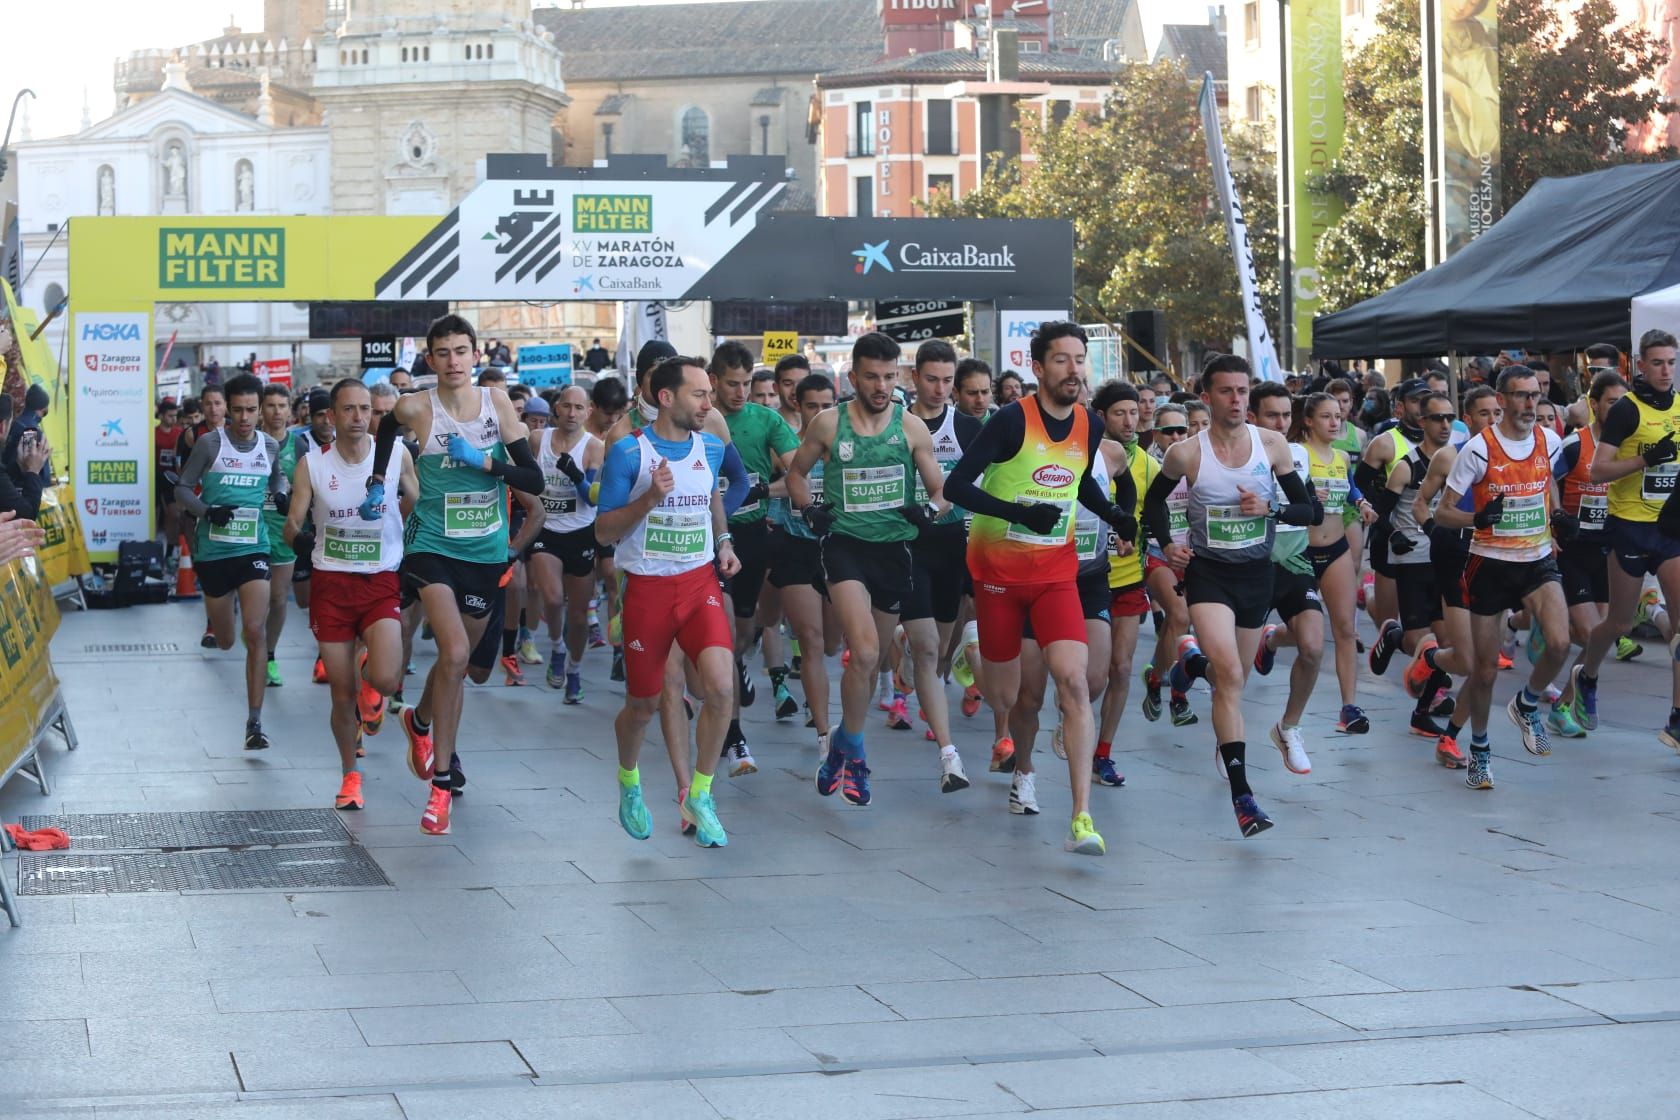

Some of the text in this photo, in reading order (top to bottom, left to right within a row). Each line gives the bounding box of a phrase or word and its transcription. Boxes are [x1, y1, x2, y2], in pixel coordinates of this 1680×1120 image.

[880, 110, 891, 195] HOTEL
[1480, 151, 1493, 236] IOCESANO
[577, 198, 648, 212] MANN
[577, 214, 649, 230] FILTER
[166, 233, 278, 257] MANN
[572, 236, 674, 252] XV MARATÓN
[573, 255, 684, 268] DE ZARAGOZA
[900, 243, 1016, 267] CaixaBank
[166, 259, 279, 282] FILTER
[599, 275, 662, 289] CaixaBank
[82, 324, 141, 341] HOKA
[1008, 321, 1041, 338] HO
[365, 342, 392, 354] 10K
[767, 339, 793, 350] 42K
[101, 354, 141, 365] Zaragoza
[90, 461, 136, 472] MANN
[90, 472, 136, 483] FILTER
[220, 474, 261, 487] ATLEET
[1037, 470, 1072, 483] Serrano
[851, 482, 899, 497] SUAREZ
[101, 498, 140, 508] Zaragoza
[456, 506, 494, 521] OSANZ
[1501, 511, 1540, 523] CHEMA
[224, 522, 250, 531] ABLO
[1221, 521, 1256, 534] MAYO
[649, 531, 704, 545] ALLUEVA
[328, 541, 376, 554] CALERO
